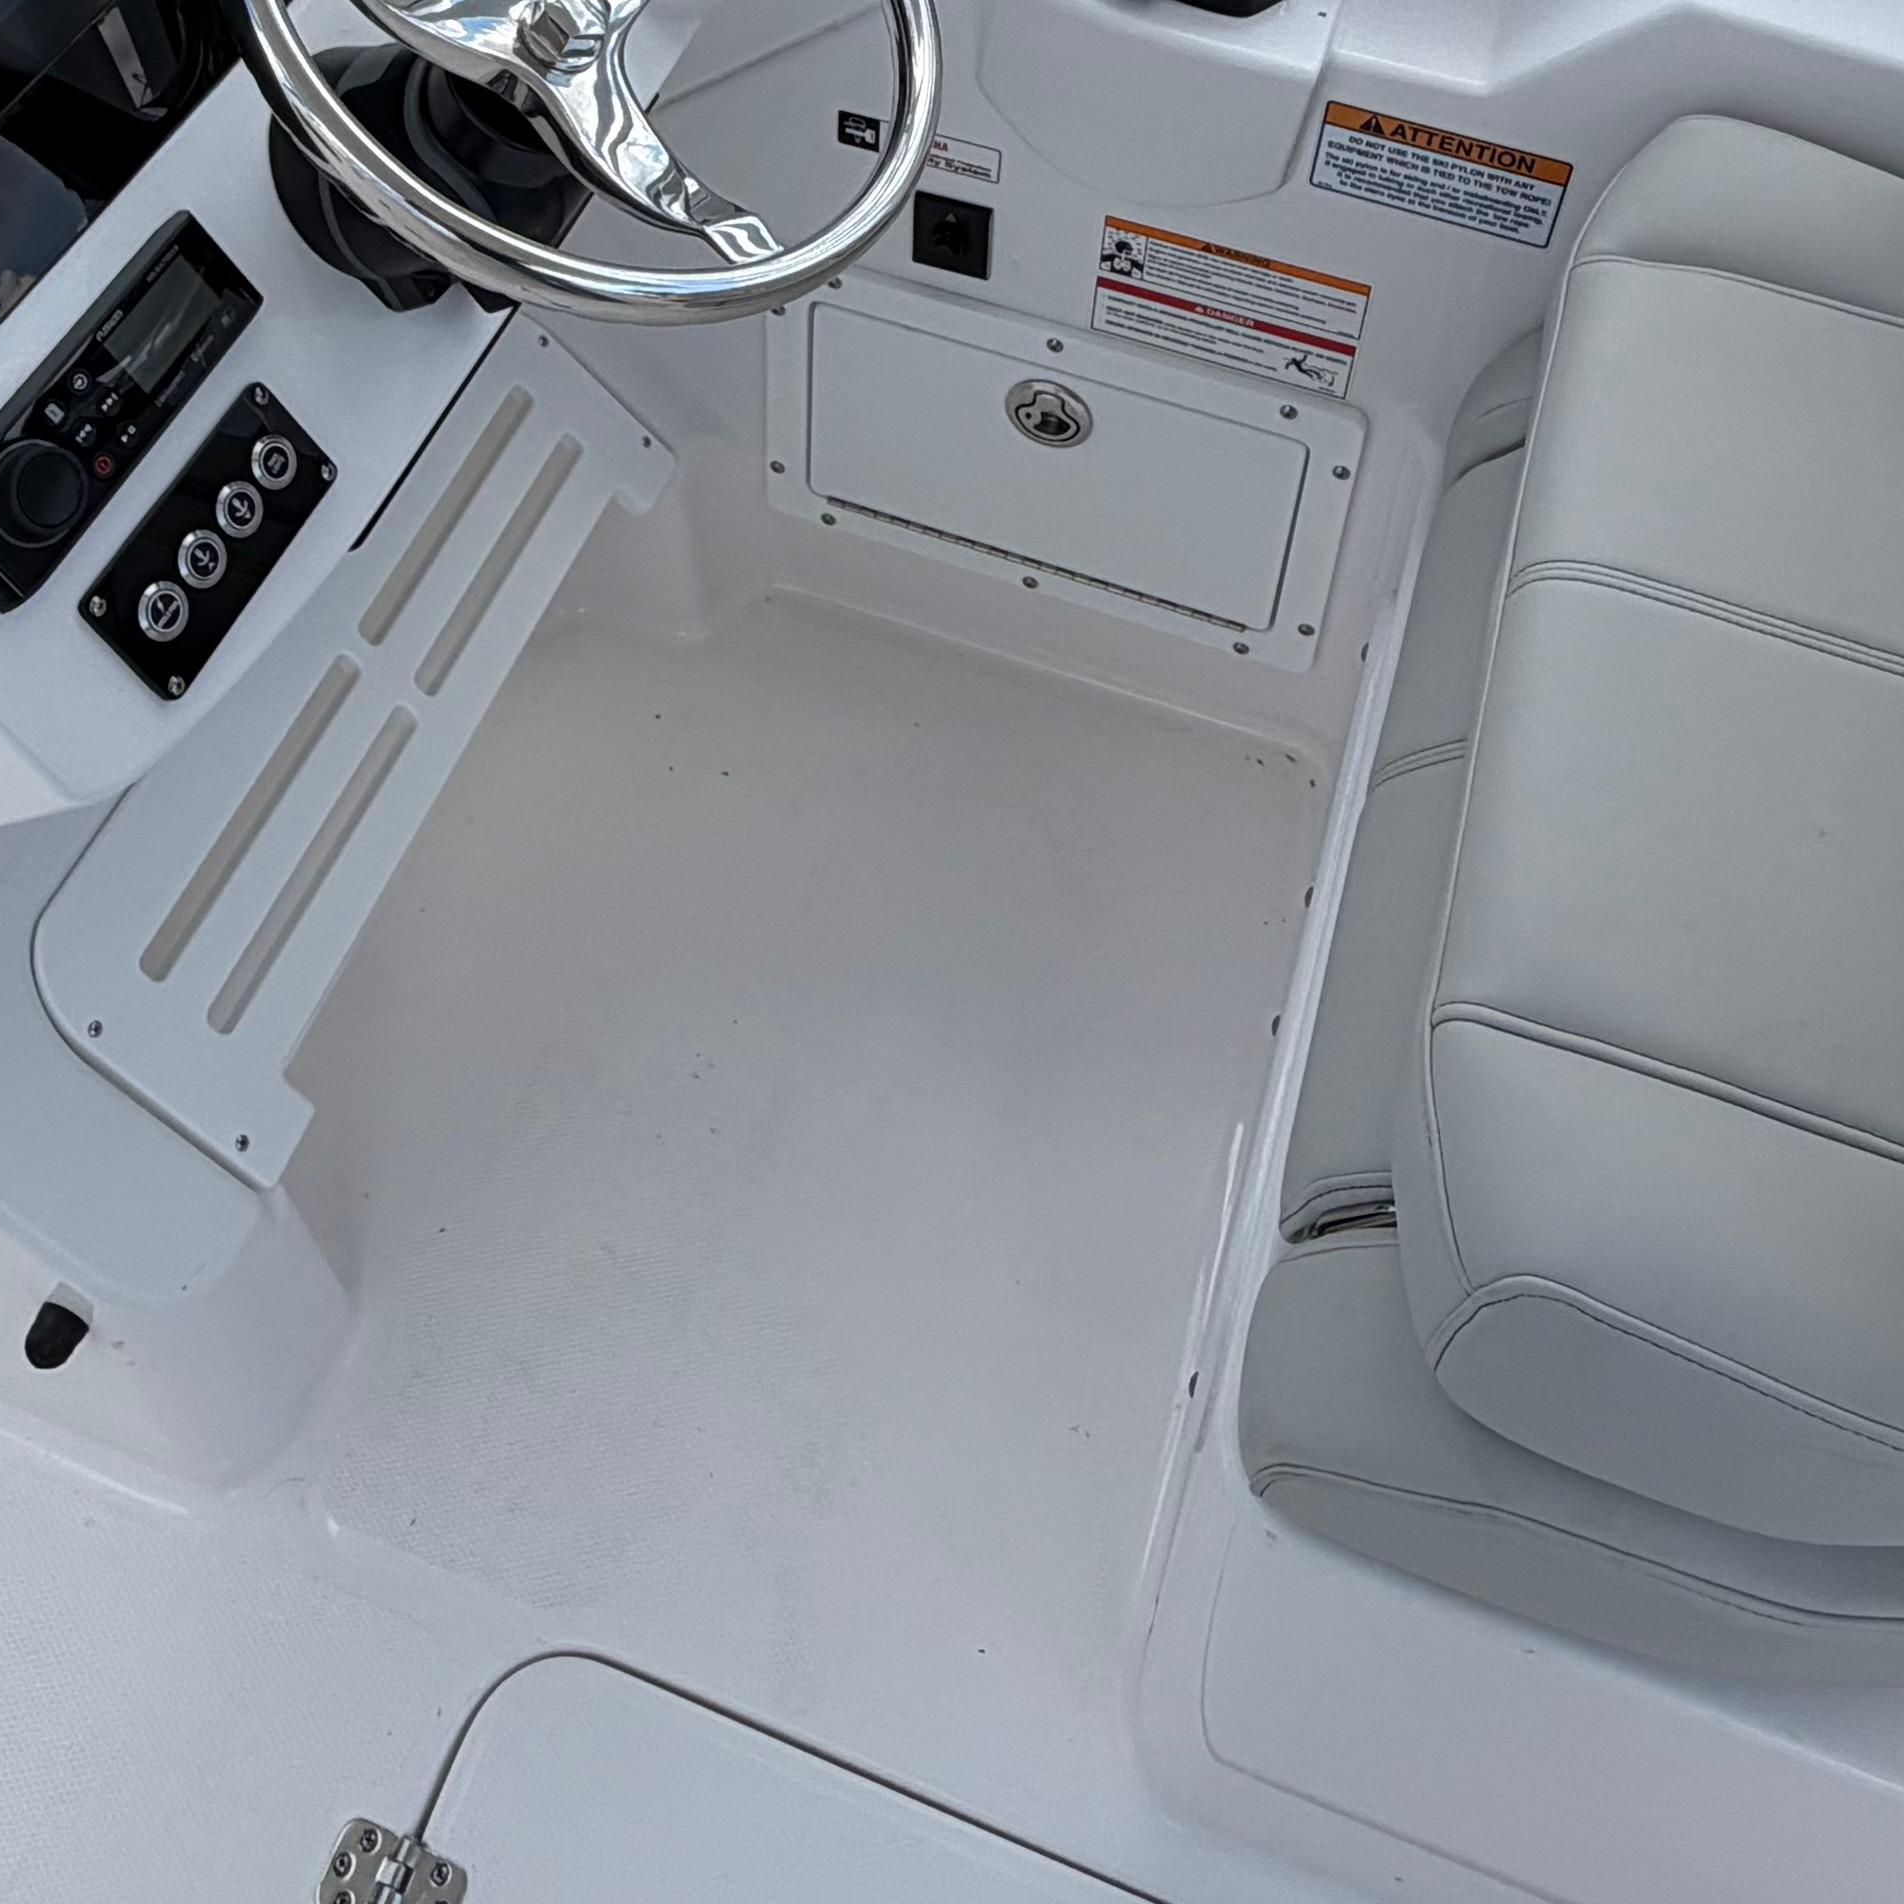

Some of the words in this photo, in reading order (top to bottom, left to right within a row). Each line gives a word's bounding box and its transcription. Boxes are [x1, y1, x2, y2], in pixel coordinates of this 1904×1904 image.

[1326, 139, 1384, 161] EQUIPMENT
[1385, 155, 1419, 171] WHICH
[1432, 168, 1456, 181] TIED
[1456, 174, 1472, 185] TO
[1472, 178, 1493, 191] THE
[1494, 184, 1518, 197] TOW
[1348, 135, 1364, 146] DO
[1364, 139, 1385, 151] NOT
[1386, 145, 1408, 157] USE
[1410, 151, 1430, 163] THE
[1449, 162, 1485, 178] PYLON
[1486, 172, 1513, 185] WITH
[1389, 121, 1537, 174] ATTENTION
[1205, 307, 1256, 328] DANGER
